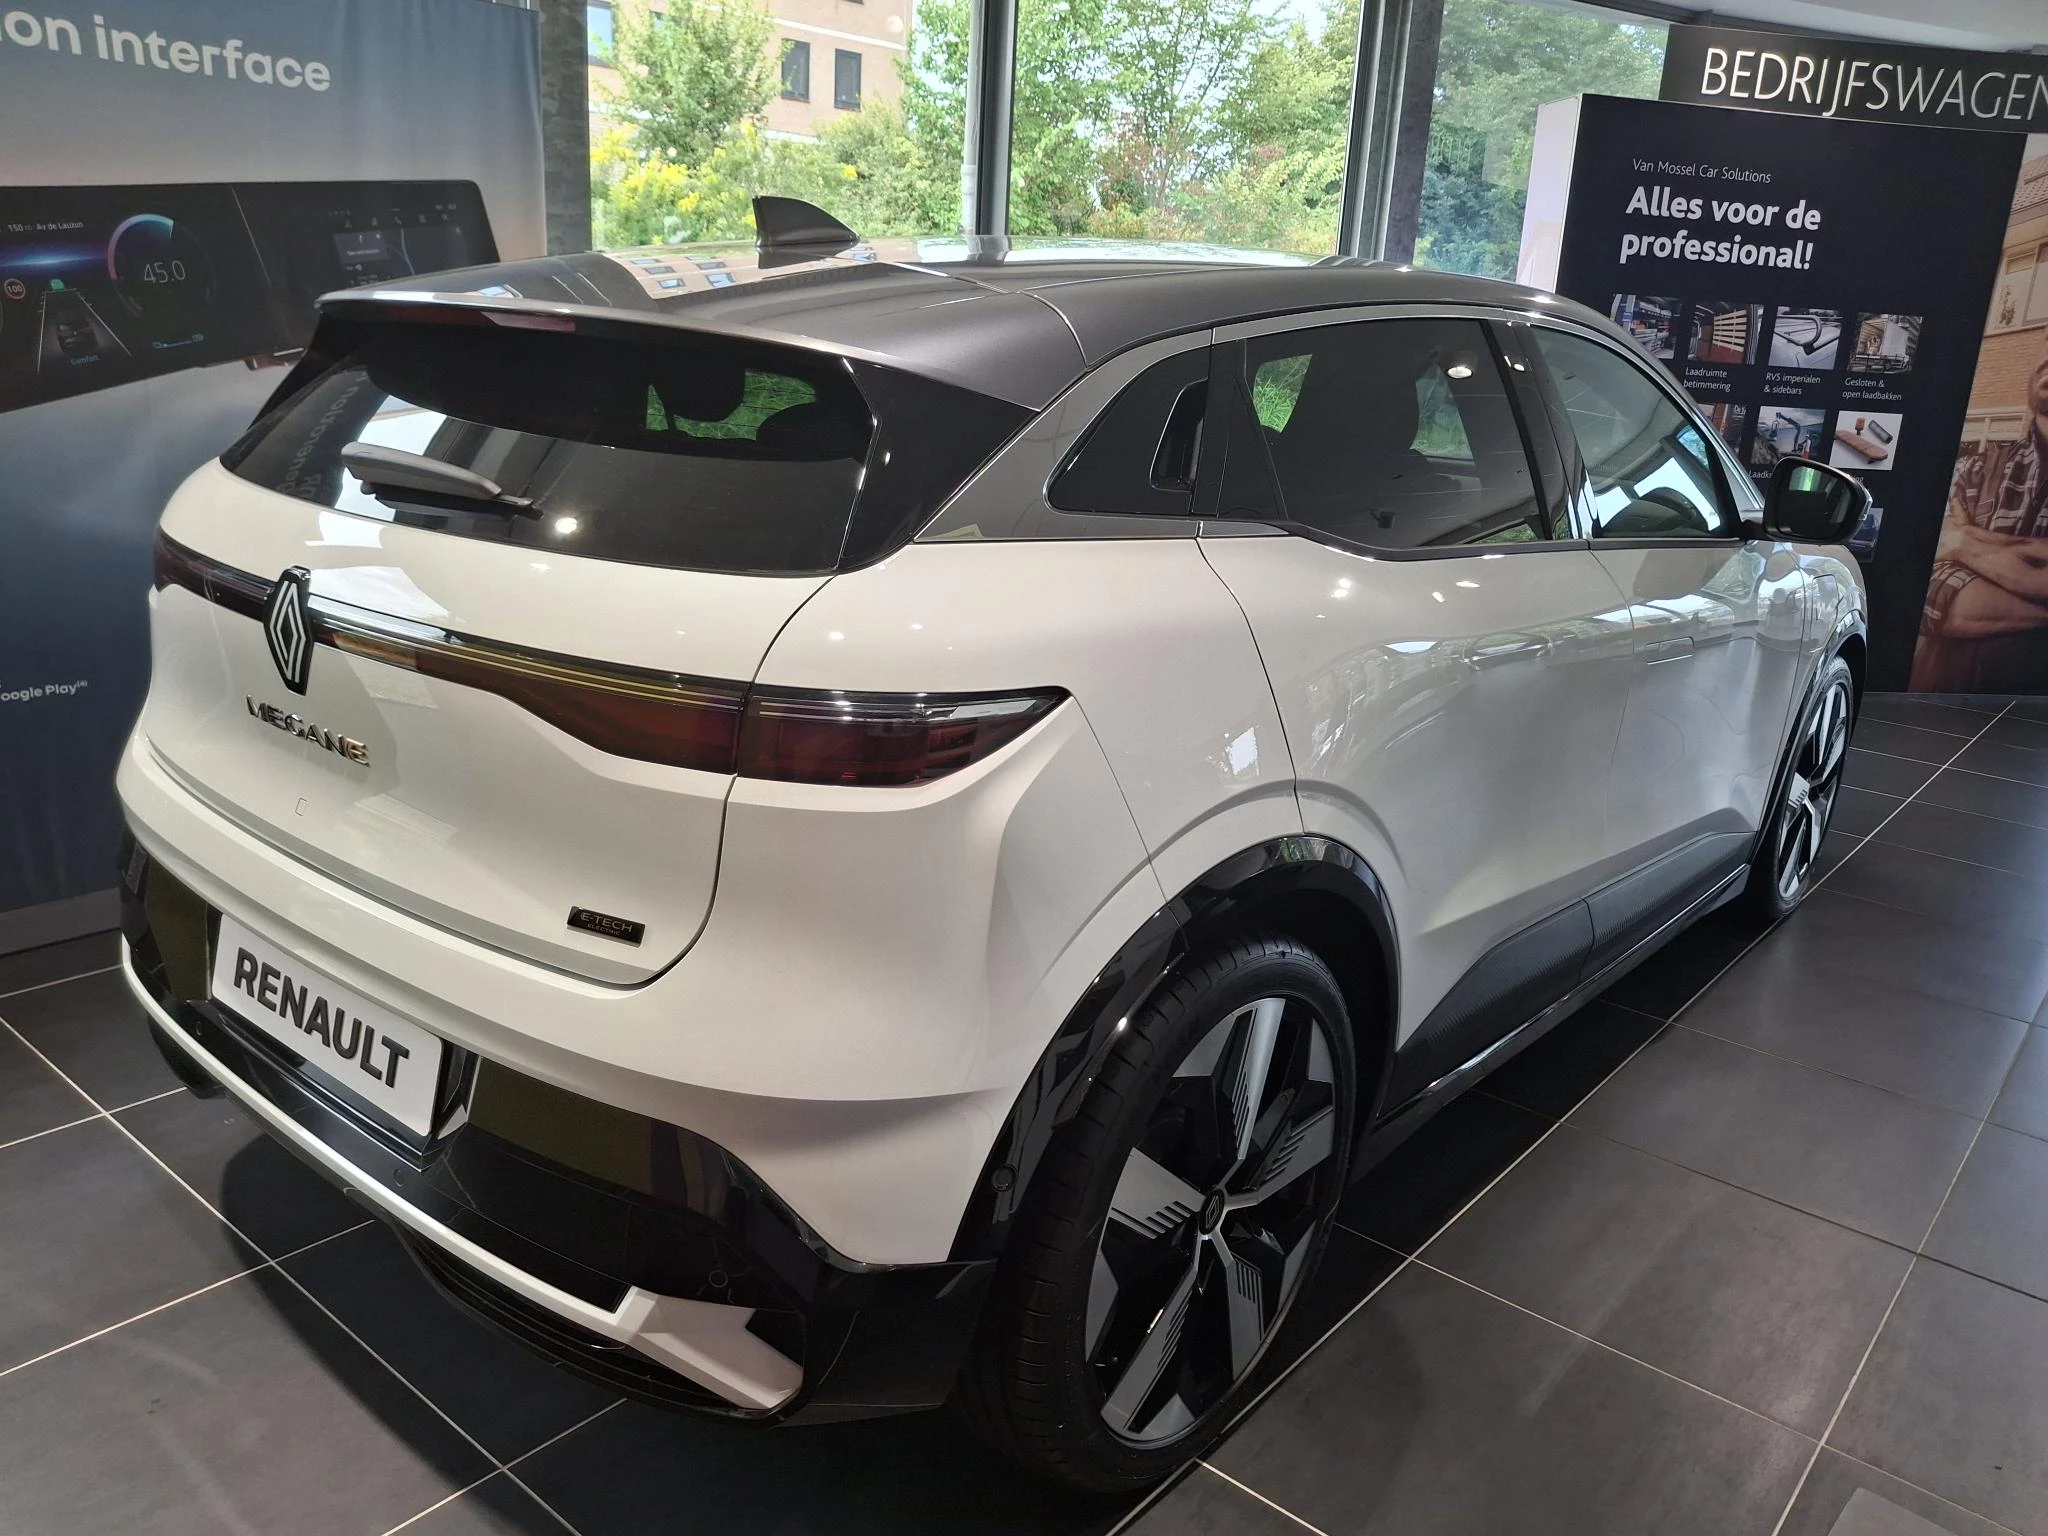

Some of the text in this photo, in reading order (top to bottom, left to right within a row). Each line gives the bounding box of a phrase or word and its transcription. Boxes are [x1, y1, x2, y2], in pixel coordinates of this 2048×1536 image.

[0, 10, 331, 91] on interface
[1633, 158, 1772, 184] Van Mossel Car Solutions
[1625, 186, 1821, 230] Alles voor de
[1619, 229, 1814, 270] professional!
[143, 260, 186, 283] 45.0
[70, 354, 99, 365] Comfort
[1685, 367, 1727, 378] Laadruimte
[1765, 372, 1821, 385] RVS imperialen
[1683, 378, 1732, 392] betimmering
[1763, 384, 1803, 395] & sidebars
[1844, 377, 1885, 388] Gesloten &
[1842, 389, 1902, 401] open laadbakken
[1748, 469, 1774, 480] Laadkr
[0, 686, 42, 701] oogle
[246, 694, 371, 768] MEGANE
[581, 912, 633, 932] E-TECH
[587, 923, 621, 936] ELECTRIC
[233, 946, 410, 1088] RENAULT
